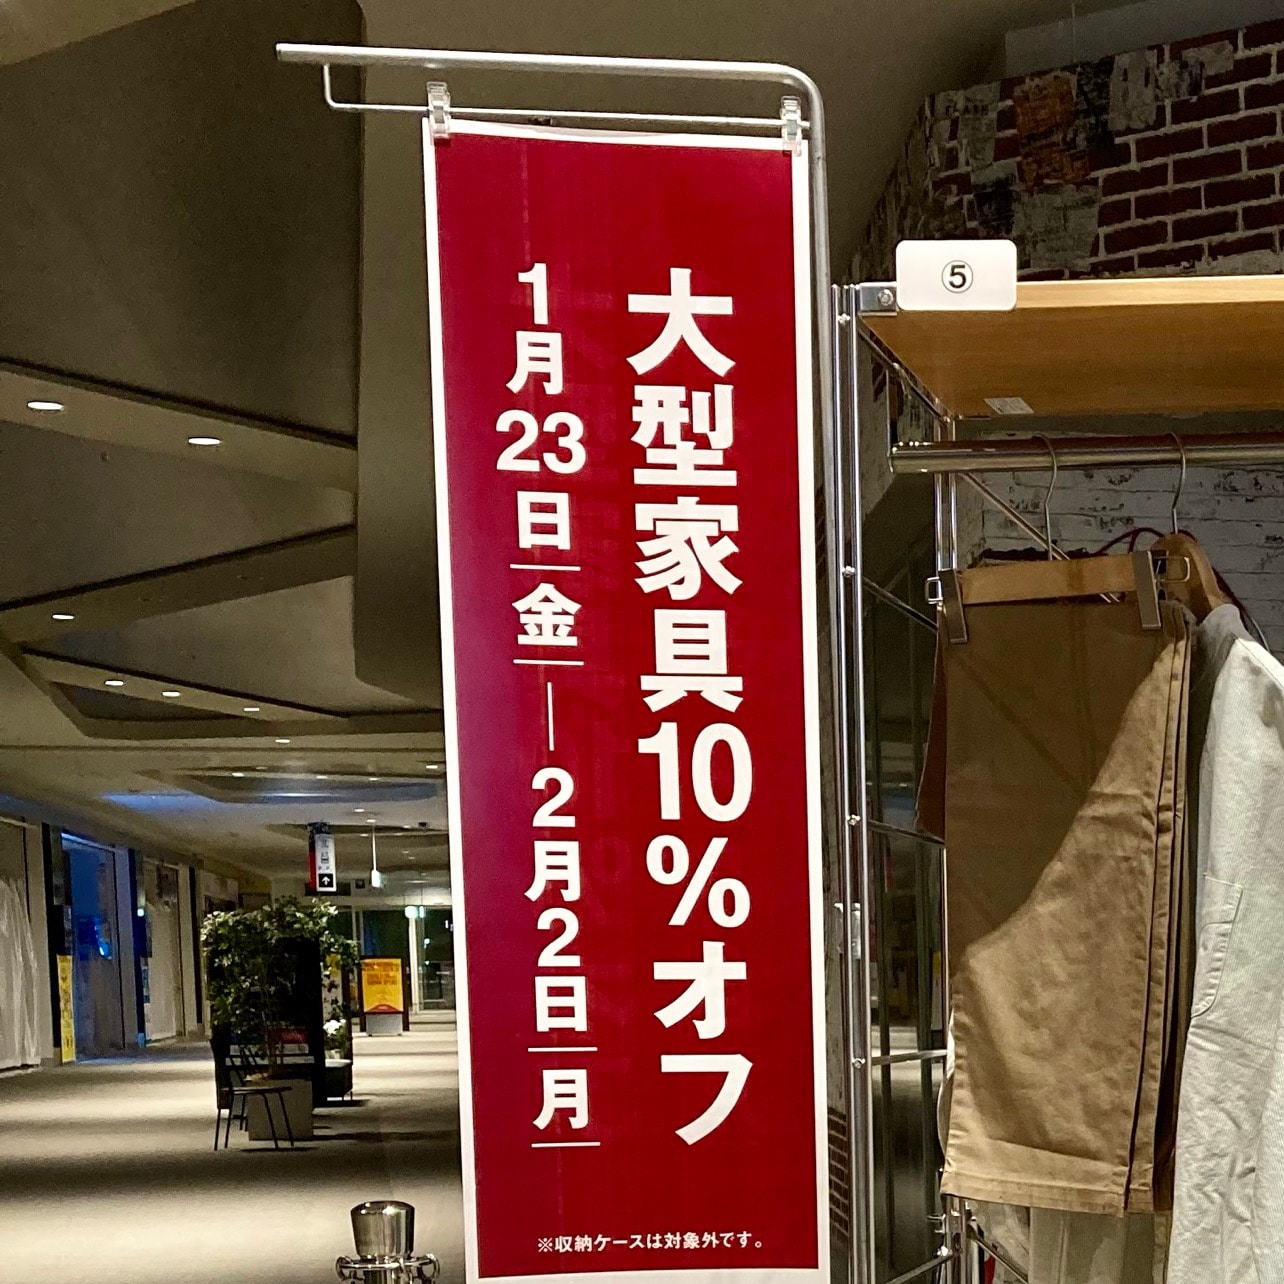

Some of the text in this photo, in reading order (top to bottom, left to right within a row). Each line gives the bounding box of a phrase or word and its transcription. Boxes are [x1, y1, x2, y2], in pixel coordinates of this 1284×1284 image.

[626, 267, 753, 1146] 大型家具10%オフ
